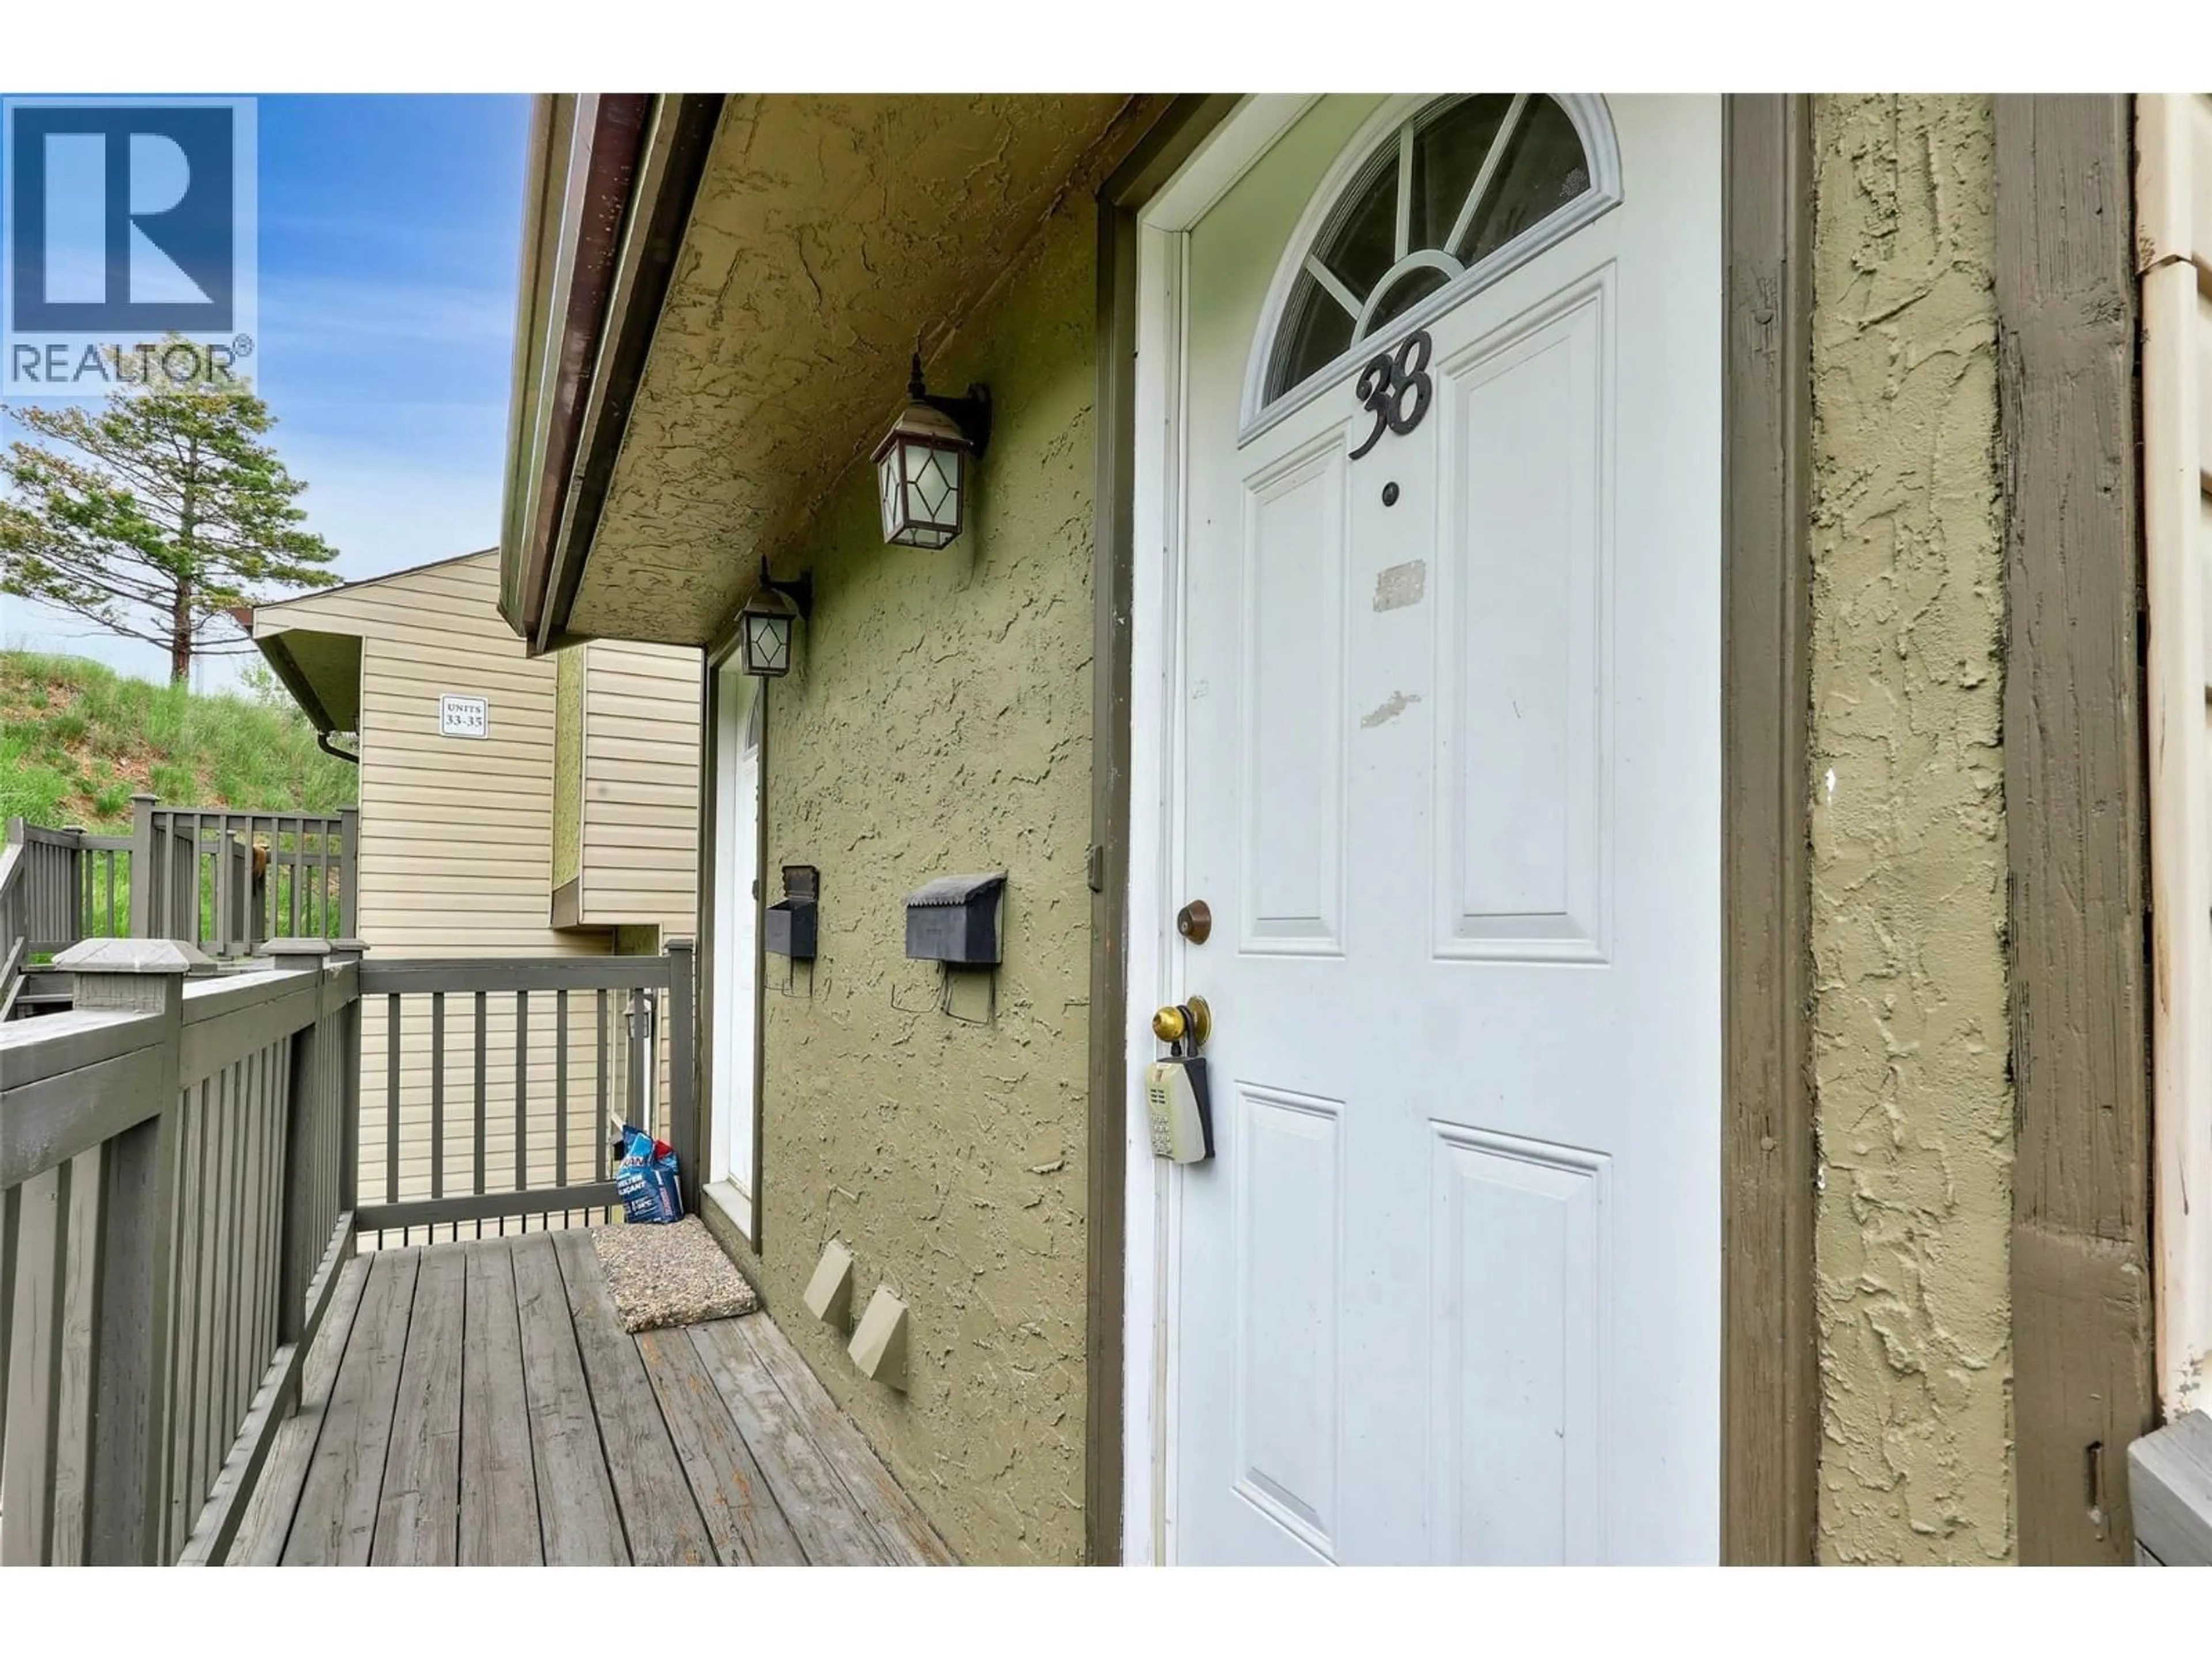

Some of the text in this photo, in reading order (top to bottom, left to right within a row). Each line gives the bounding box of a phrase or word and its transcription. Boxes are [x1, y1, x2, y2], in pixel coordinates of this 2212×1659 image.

[1348, 328, 1433, 461] 38
[447, 703, 482, 713] UNITS
[445, 714, 483, 728] 33-35
